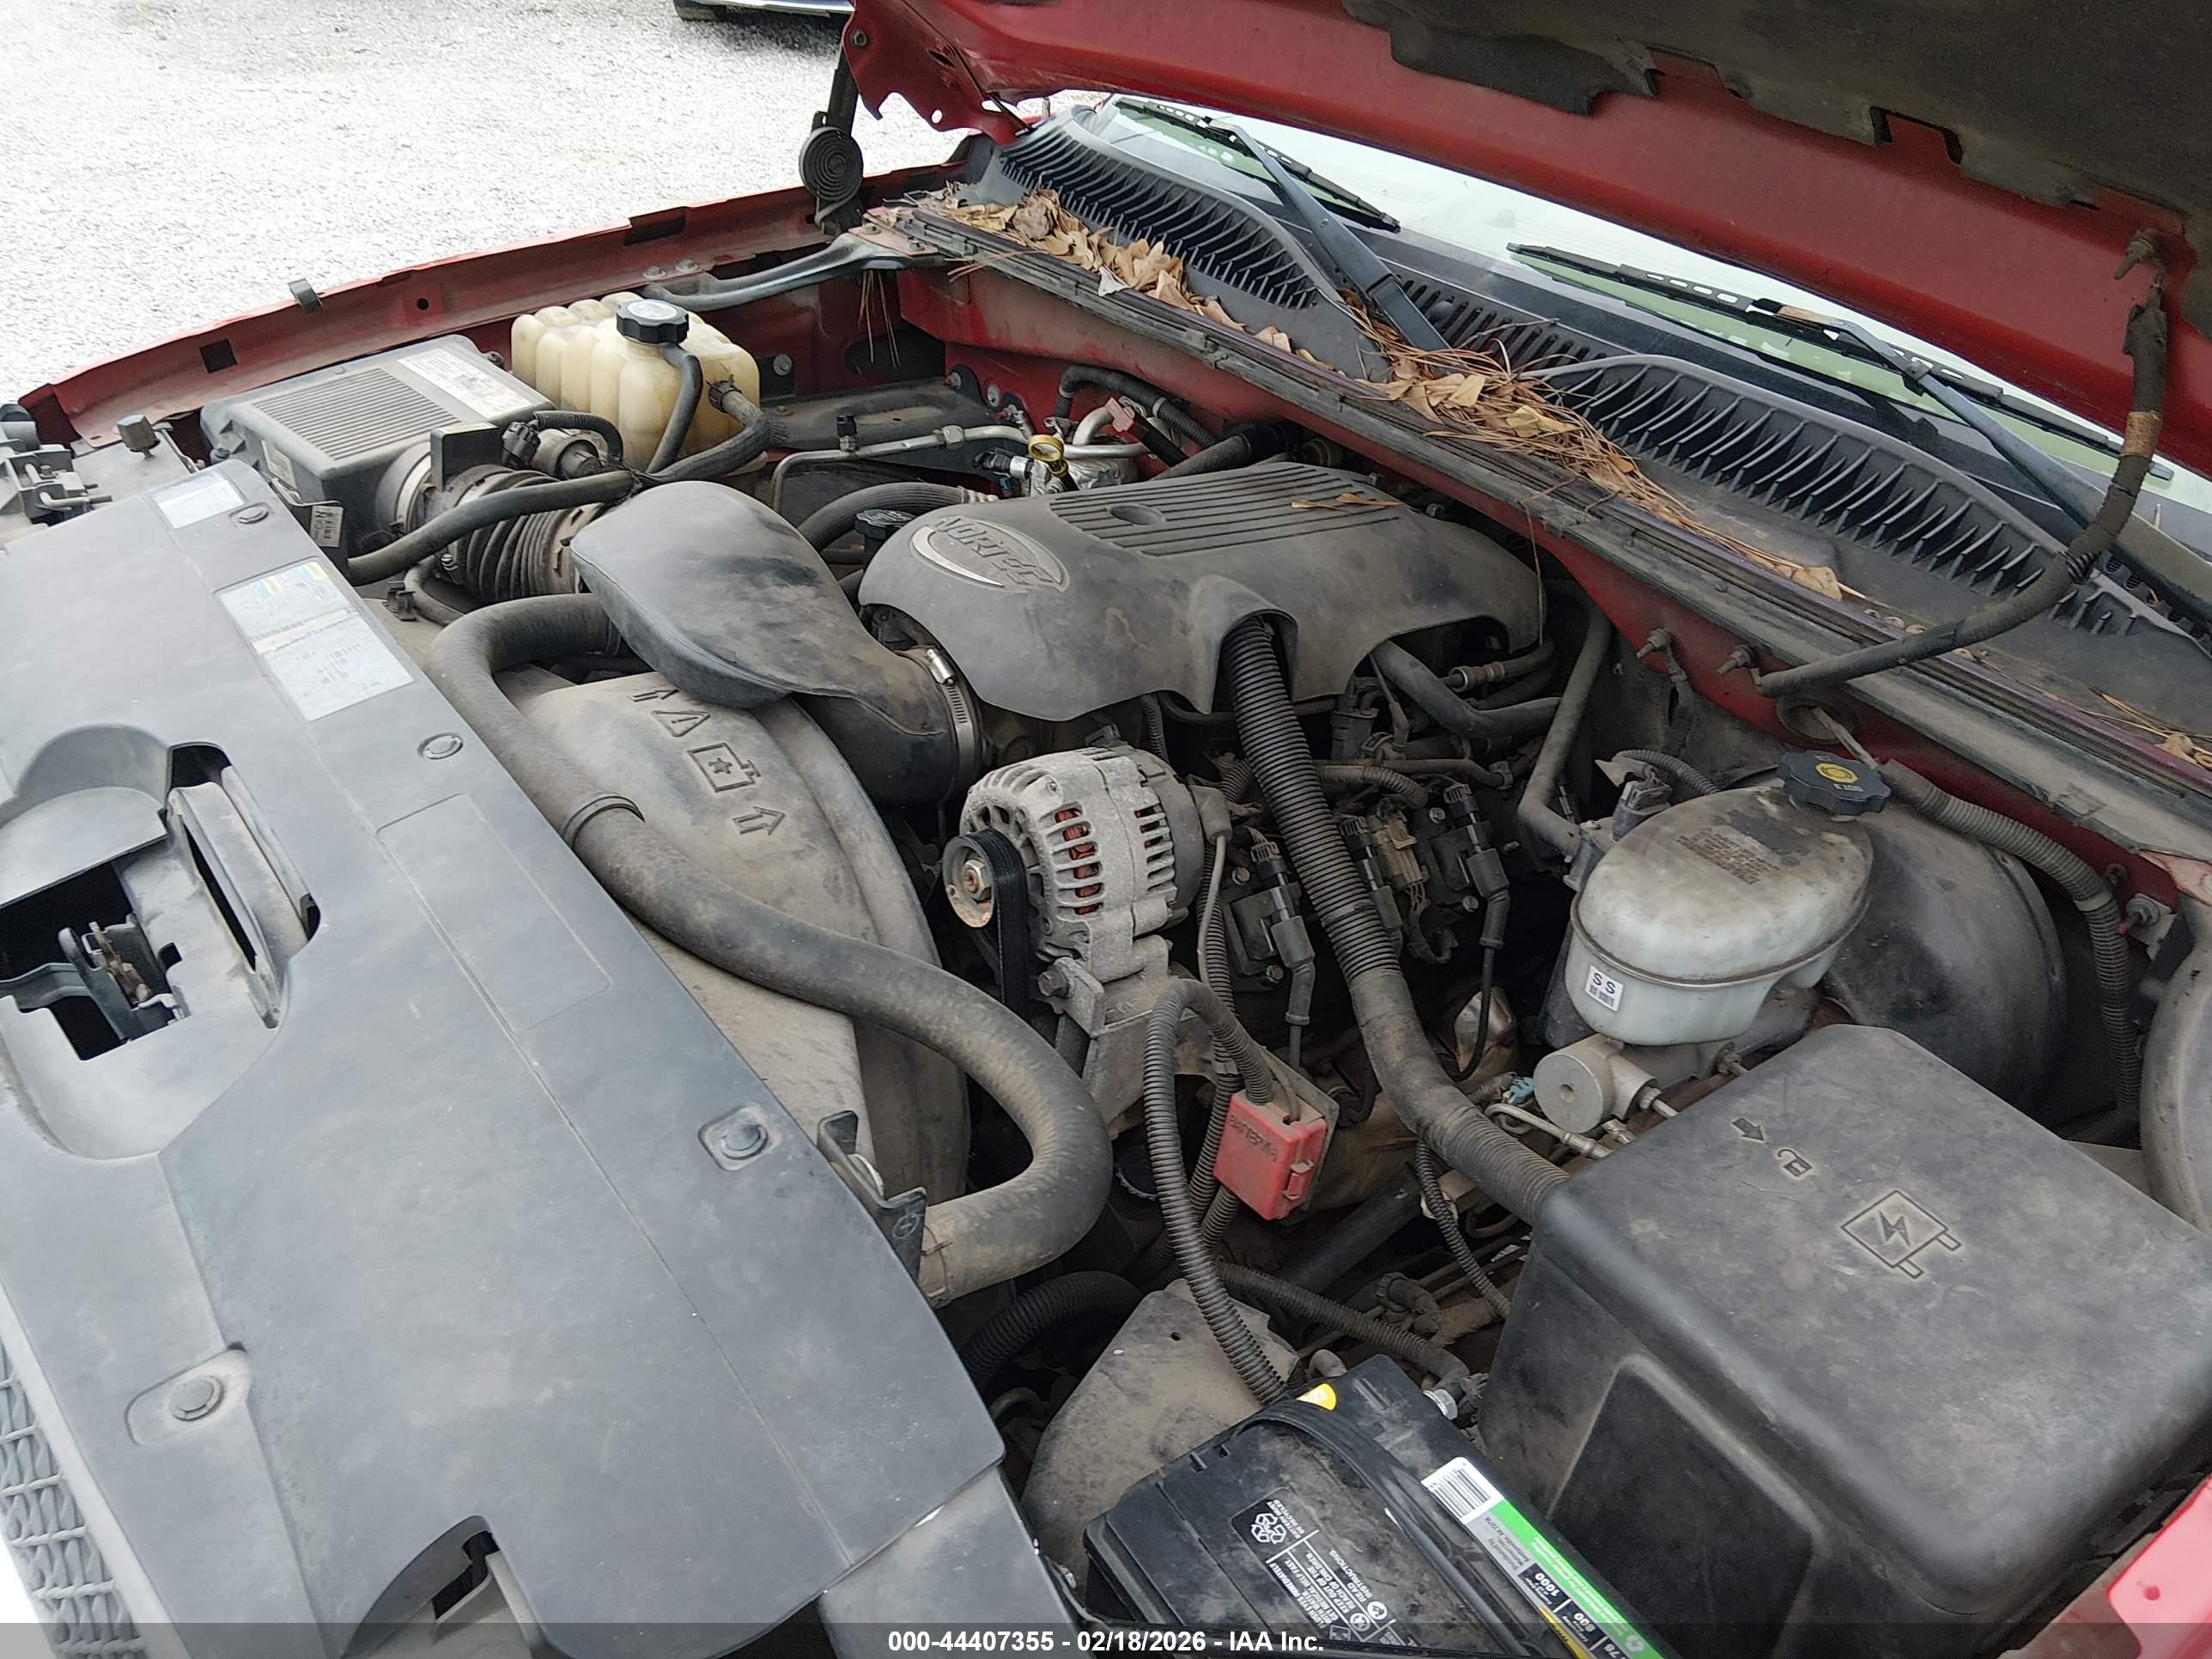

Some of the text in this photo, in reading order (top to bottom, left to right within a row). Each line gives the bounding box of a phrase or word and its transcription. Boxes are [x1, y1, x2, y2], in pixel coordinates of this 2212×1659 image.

[1294, 1571, 1310, 1588] HELP
[1327, 1547, 1373, 1603] READ INSTRUCTIONS.
[1328, 1579, 1340, 1590] OF
[1533, 1570, 1560, 1597] 1000
[1306, 1565, 1350, 1614] KEEP OUT OF THE
[1306, 1585, 1330, 1611] MEDICAL
[1334, 1588, 1356, 1610] REACH
[1571, 1610, 1595, 1633] 800
